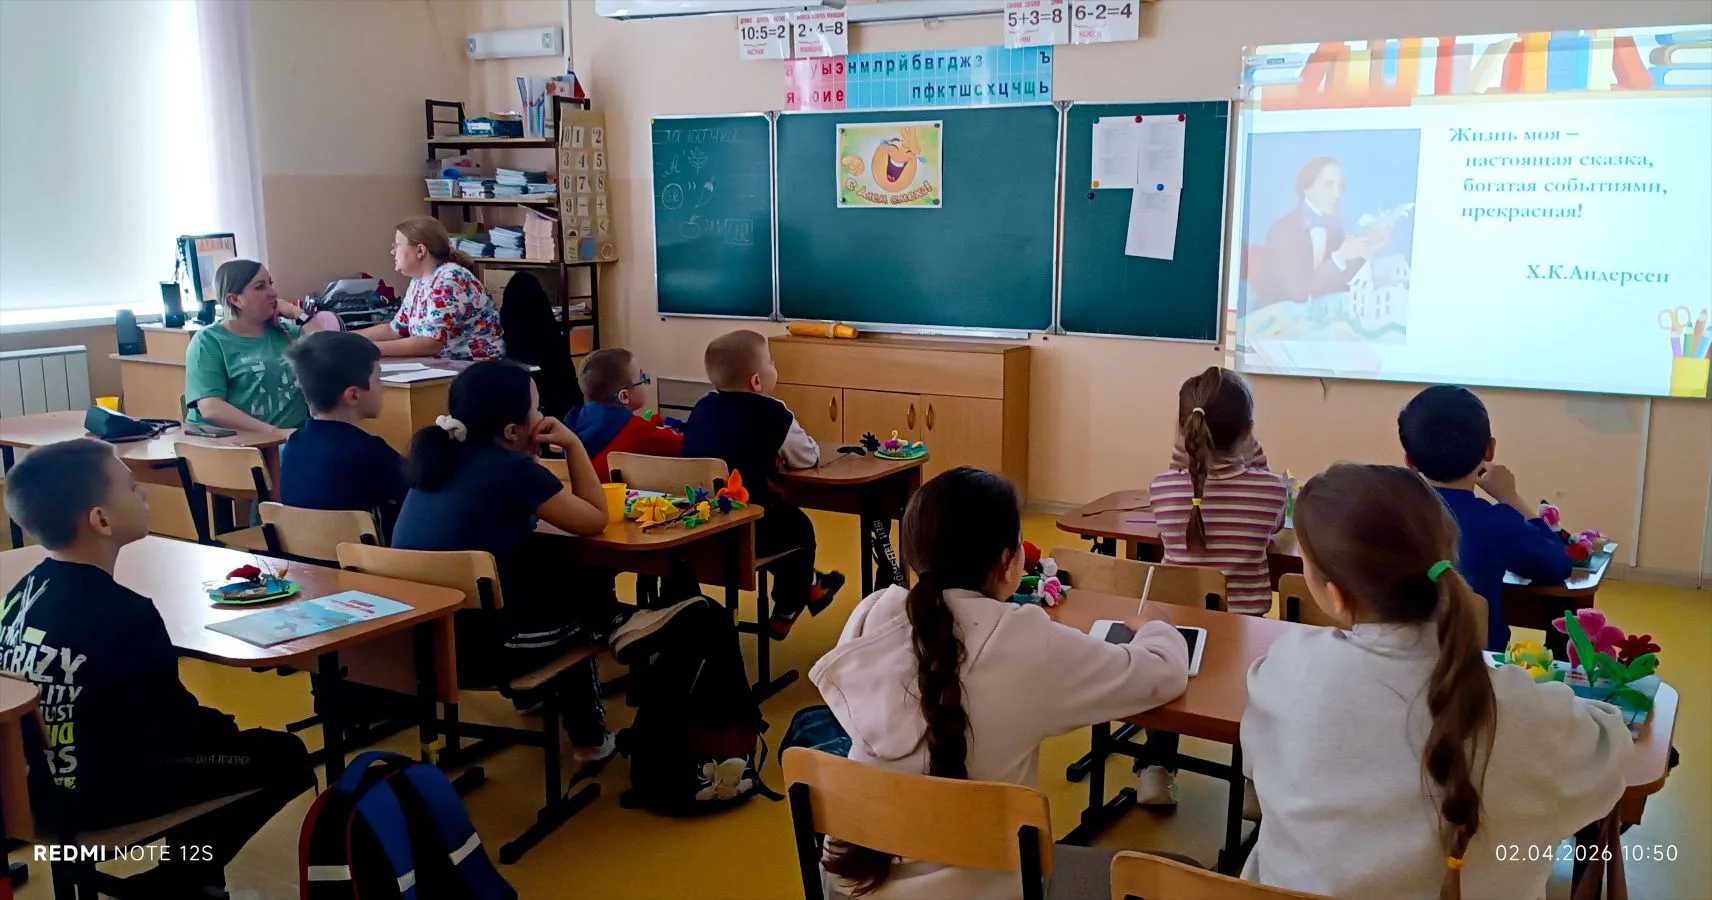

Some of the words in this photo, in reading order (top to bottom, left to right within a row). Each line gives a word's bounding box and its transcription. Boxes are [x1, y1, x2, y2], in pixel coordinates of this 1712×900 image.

[1008, 8, 1062, 27] 5+3=8
[1075, 3, 1133, 20] 6-2=4
[740, 24, 786, 40] 10:5=2
[1449, 127, 1517, 142] Жизнь
[1523, 130, 1560, 141] моя
[1465, 156, 1572, 168] настоящая
[1579, 155, 1654, 169] сказка,
[1463, 178, 1537, 192] богатая
[1544, 178, 1668, 196] событиями,
[1461, 204, 1583, 222] прекрасная!
